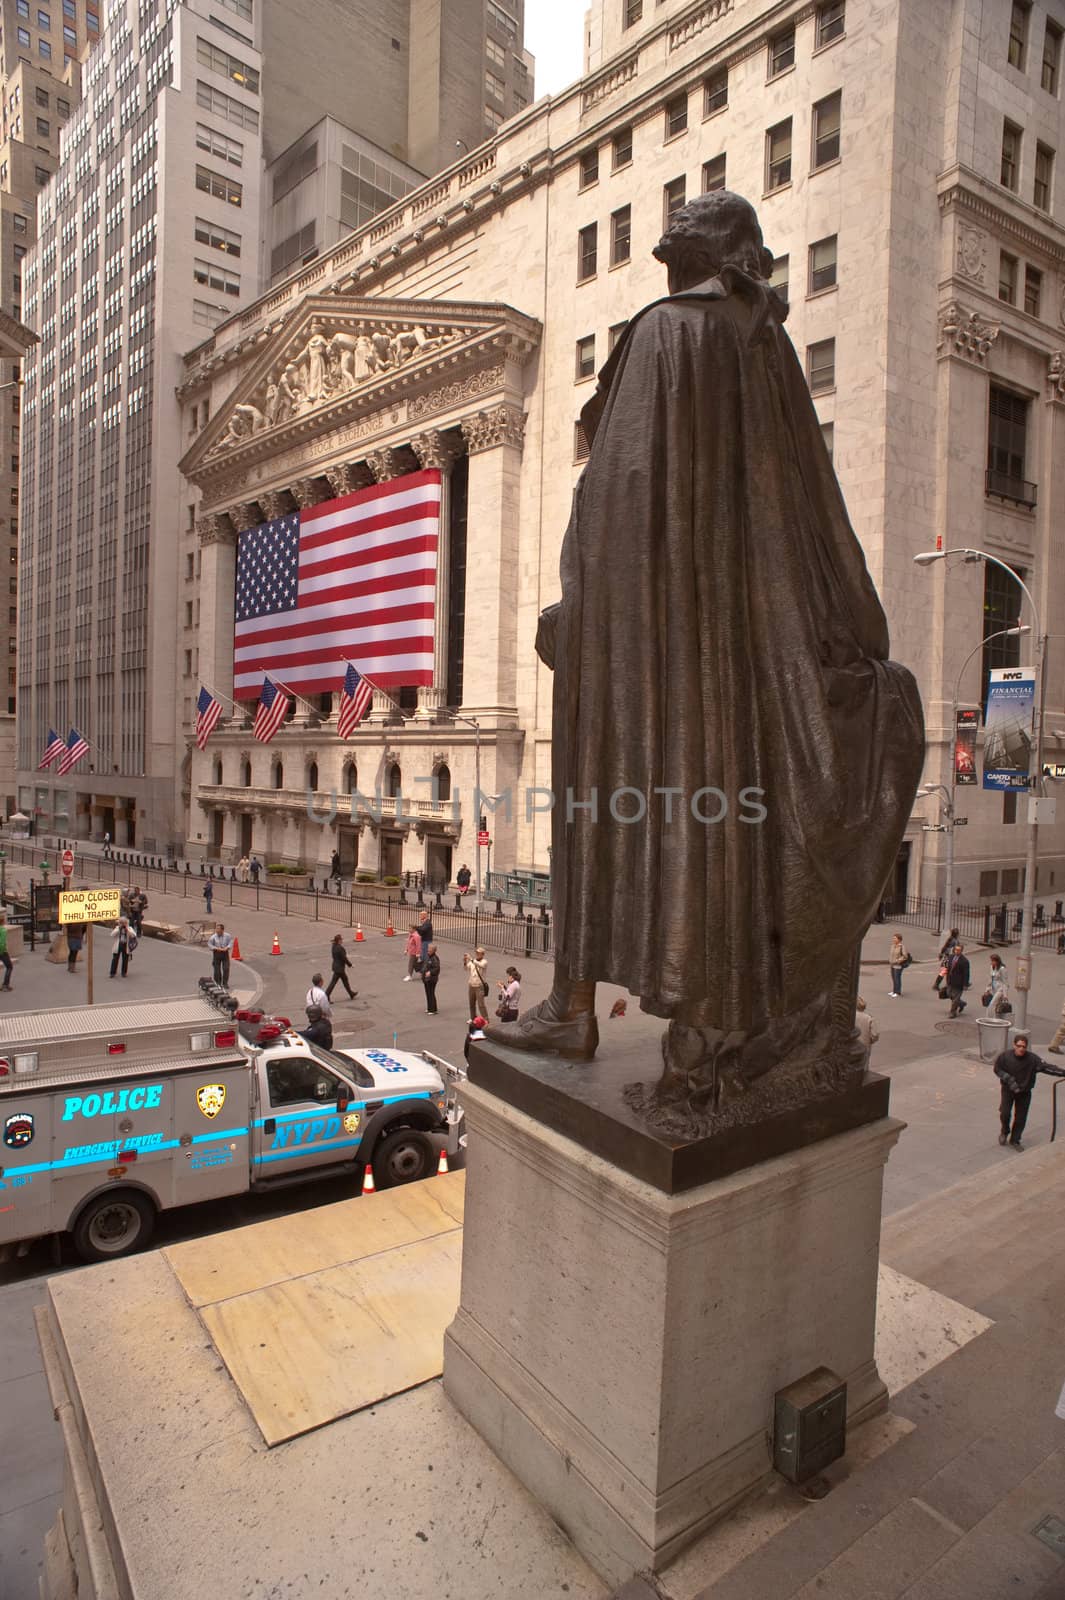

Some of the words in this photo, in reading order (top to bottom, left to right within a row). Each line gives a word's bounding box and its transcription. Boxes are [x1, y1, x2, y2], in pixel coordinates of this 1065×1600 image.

[337, 416, 384, 446] EXCHANGE
[1002, 672, 1023, 680] NYC
[991, 687, 1033, 695] FINANCIAL
[62, 893, 85, 904] ROAD
[87, 891, 119, 902] CLOSED
[84, 902, 98, 911] NO
[63, 912, 85, 921] THRU
[87, 909, 118, 919] TRAFFIC
[62, 1085, 163, 1121] POLICE
[271, 1117, 341, 1150] NYPD
[63, 1140, 123, 1161] EMERGENCY
[123, 1132, 164, 1150] SERVICE
